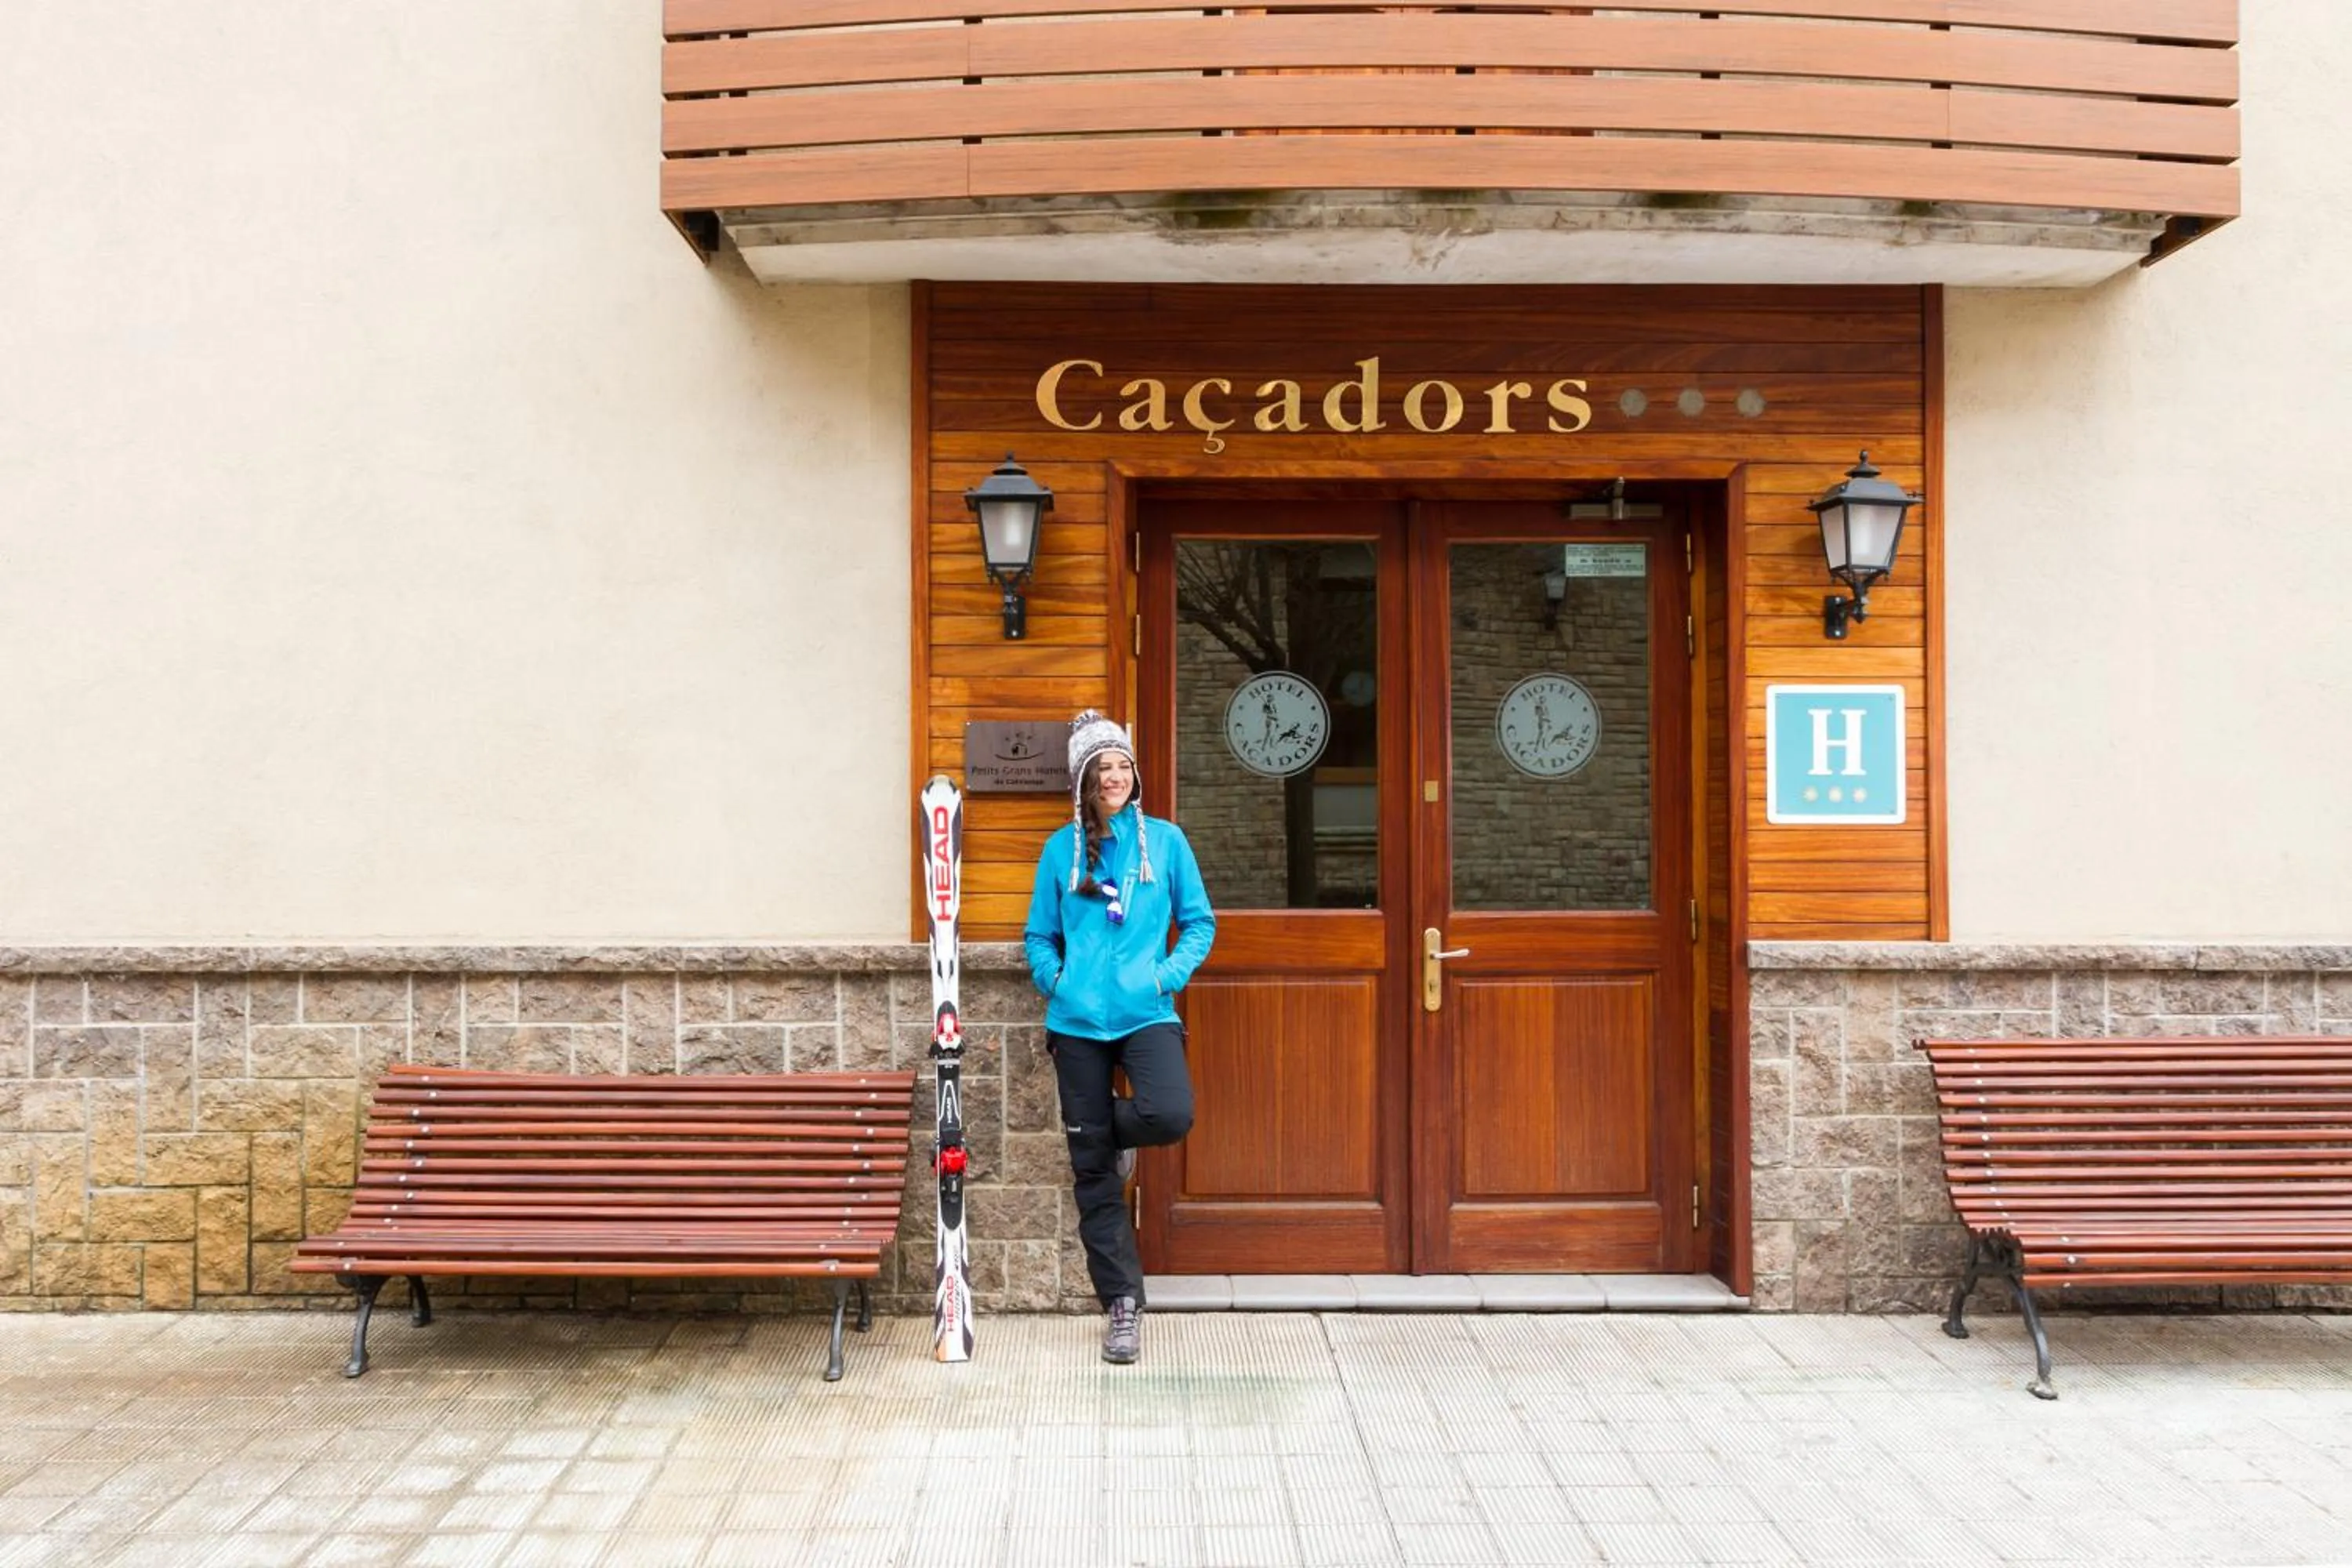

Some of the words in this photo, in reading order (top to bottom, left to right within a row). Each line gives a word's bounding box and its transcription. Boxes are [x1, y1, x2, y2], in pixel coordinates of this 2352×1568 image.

[1036, 355, 1592, 454] Caçadors
[1248, 681, 1304, 700] HOTEL
[1521, 682, 1576, 703] HOTEL
[1234, 722, 1319, 766] CAÇADORS
[1507, 724, 1591, 768] CAÇADORS
[1807, 709, 1867, 775] H
[934, 805, 952, 921] HEAD
